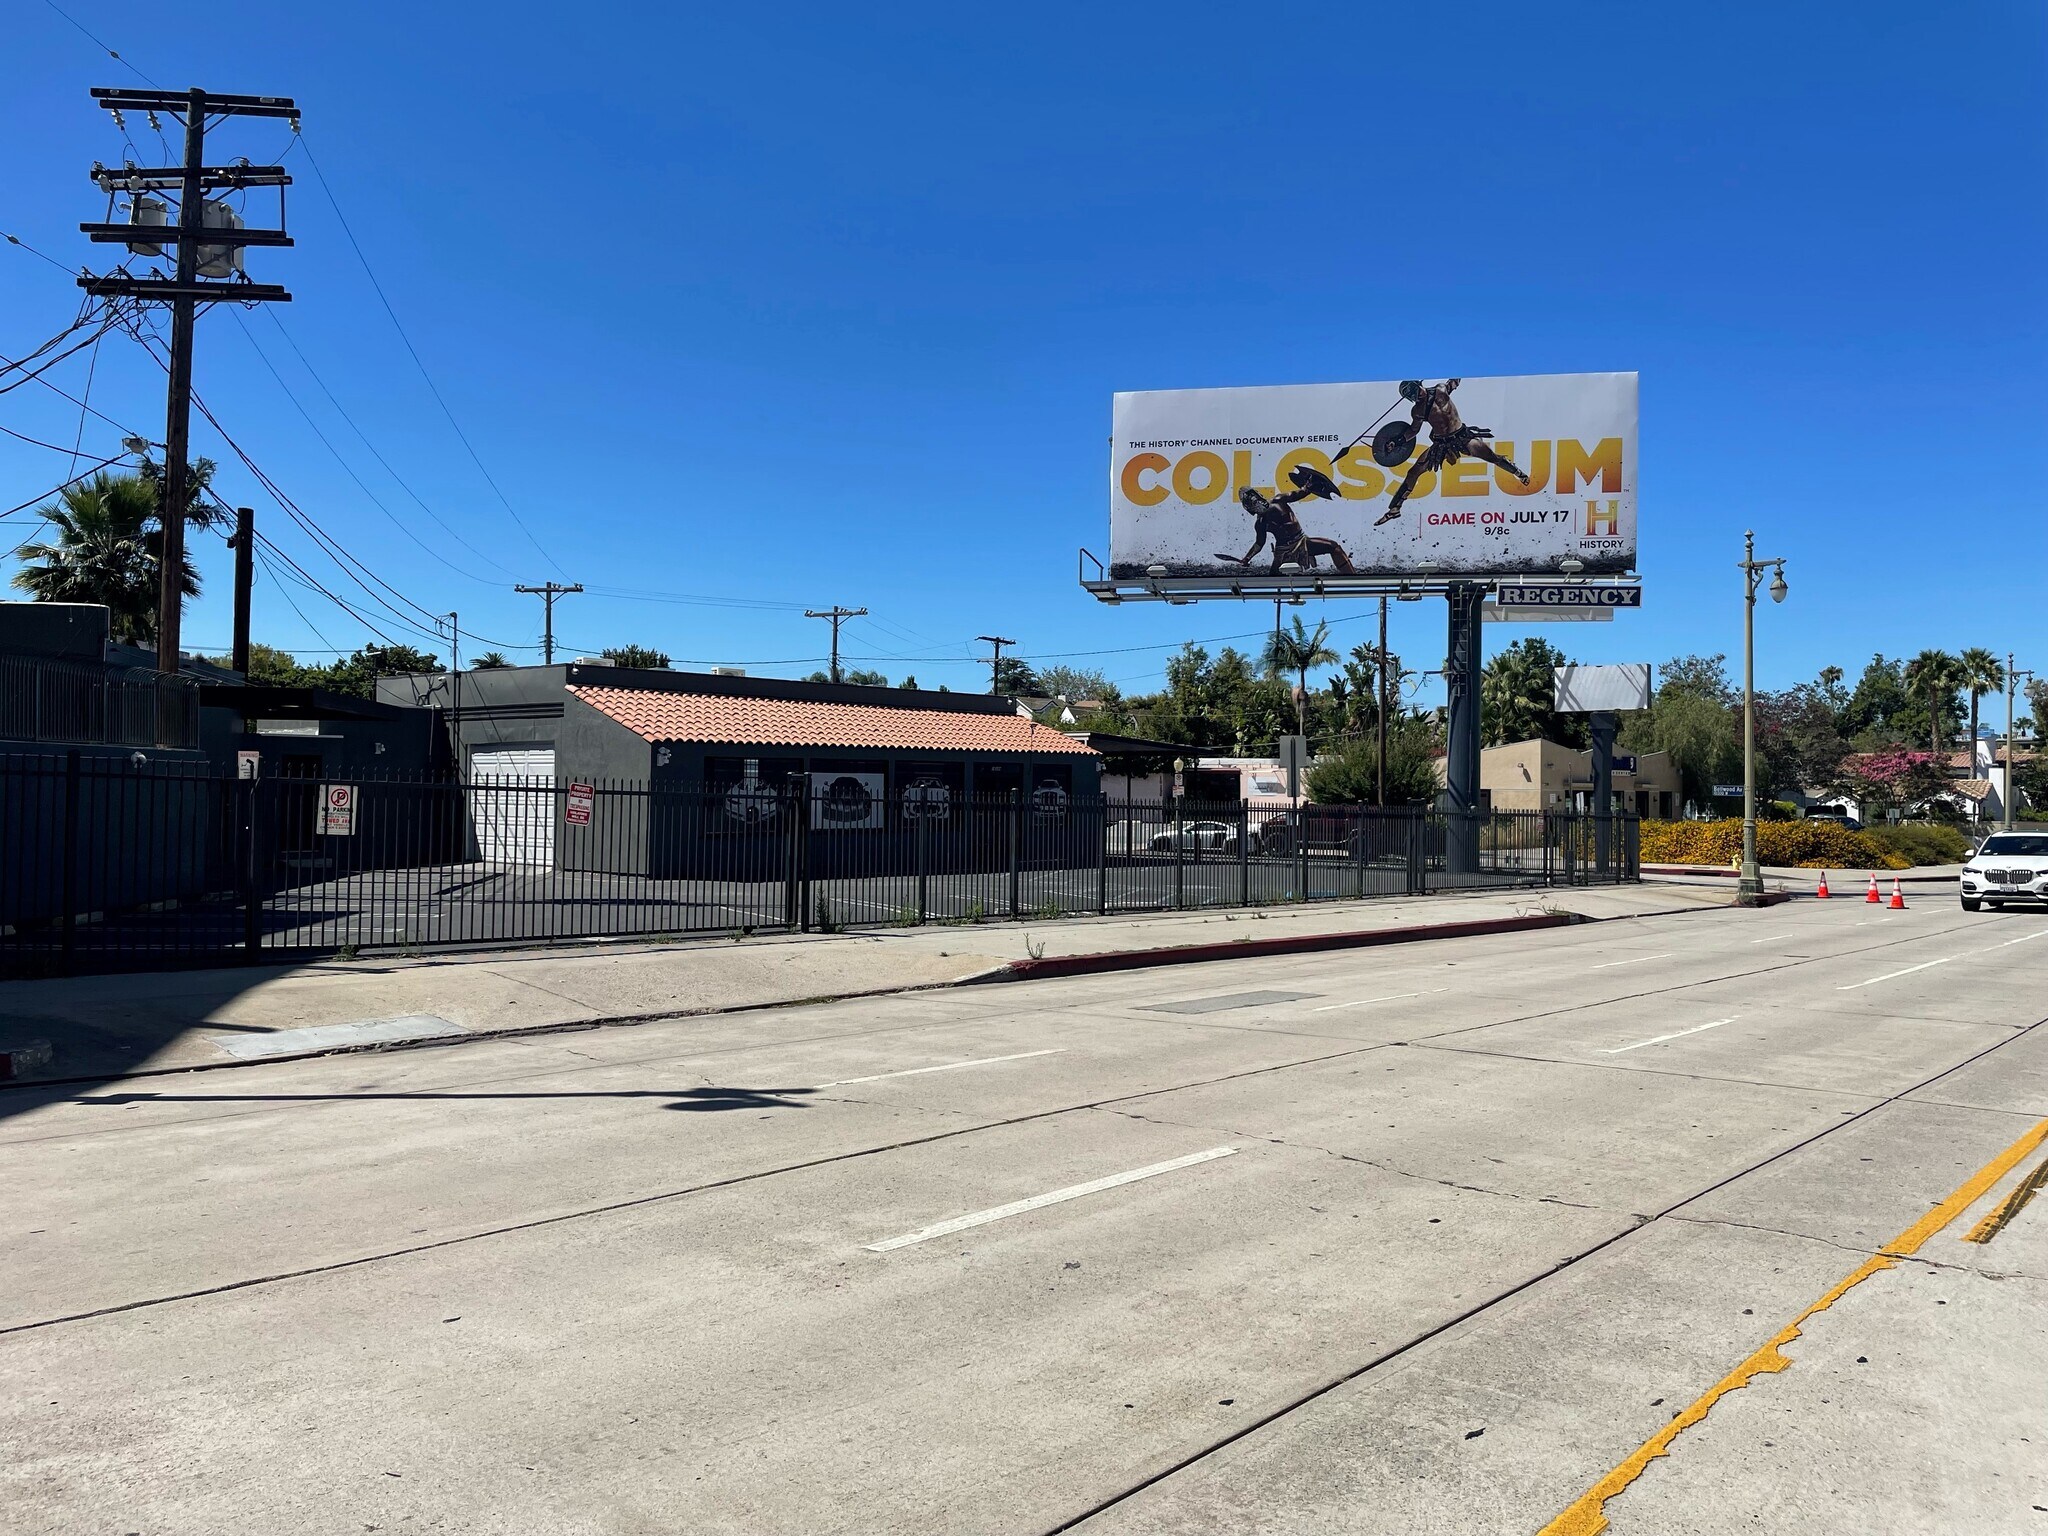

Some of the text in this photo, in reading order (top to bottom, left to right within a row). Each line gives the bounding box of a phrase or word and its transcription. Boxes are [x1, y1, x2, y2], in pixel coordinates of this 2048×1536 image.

[1190, 438, 1232, 447] CHANNEL
[1235, 435, 1305, 445] DOCUMENTARY
[1307, 434, 1339, 443] SERIES
[1121, 437, 1622, 506] COLOSSEUM
[1427, 510, 1569, 525] GAME ON JULY 17
[1484, 526, 1510, 536] 9/8c
[1579, 540, 1624, 549] HISTORY
[1502, 587, 1638, 605] REGENCY
